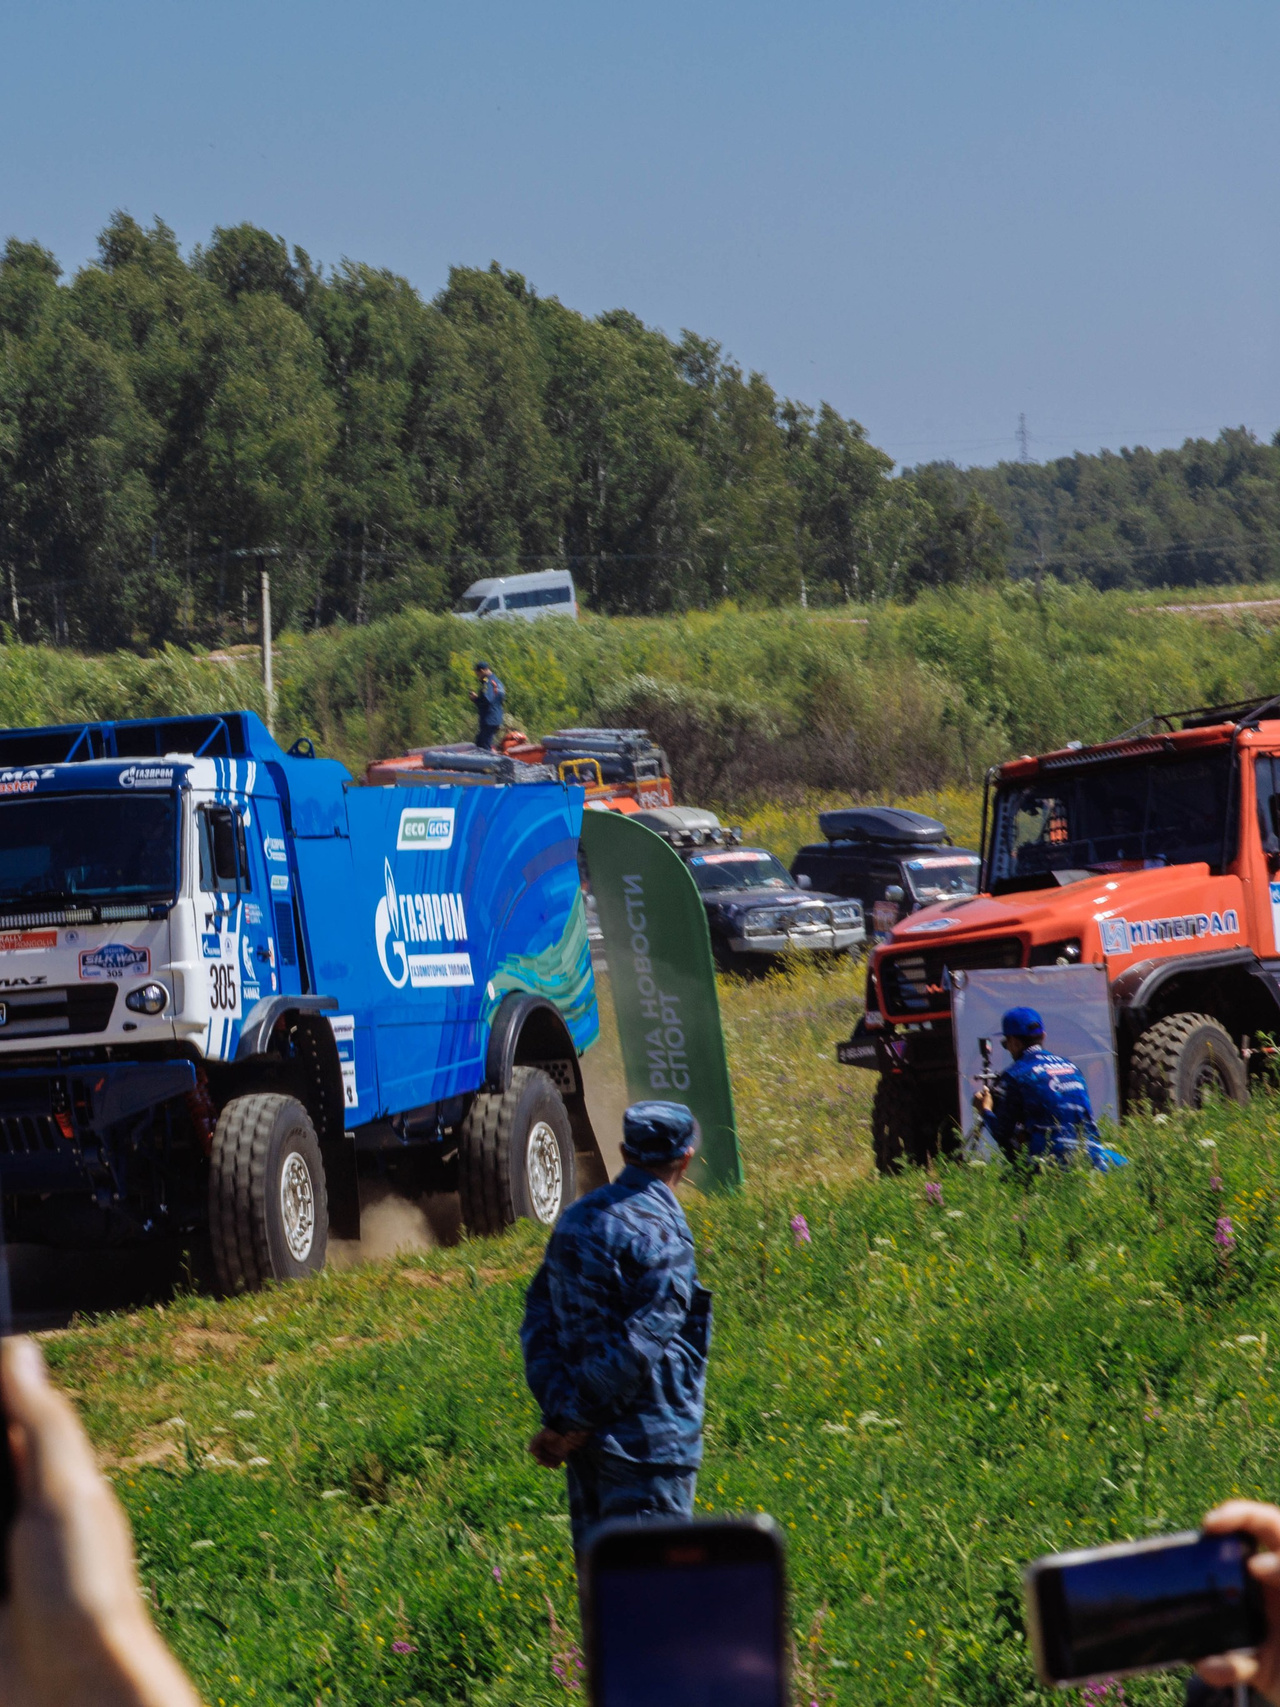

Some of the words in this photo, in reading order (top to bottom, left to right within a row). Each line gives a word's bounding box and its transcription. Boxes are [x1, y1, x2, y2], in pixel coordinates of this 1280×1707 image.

[135, 768, 174, 780] ГАЗПРОМ
[398, 893, 468, 942] ГАЗПРОМ
[1127, 909, 1240, 947] ИНТЕГРАЛ
[86, 954, 114, 965] SILK
[116, 952, 144, 963] WAY
[622, 874, 659, 1020] НОВОСТИ
[106, 969, 124, 977] 305
[210, 964, 237, 1010] 305
[647, 1027, 671, 1090] РИА
[656, 988, 691, 1091] СПОРТ
